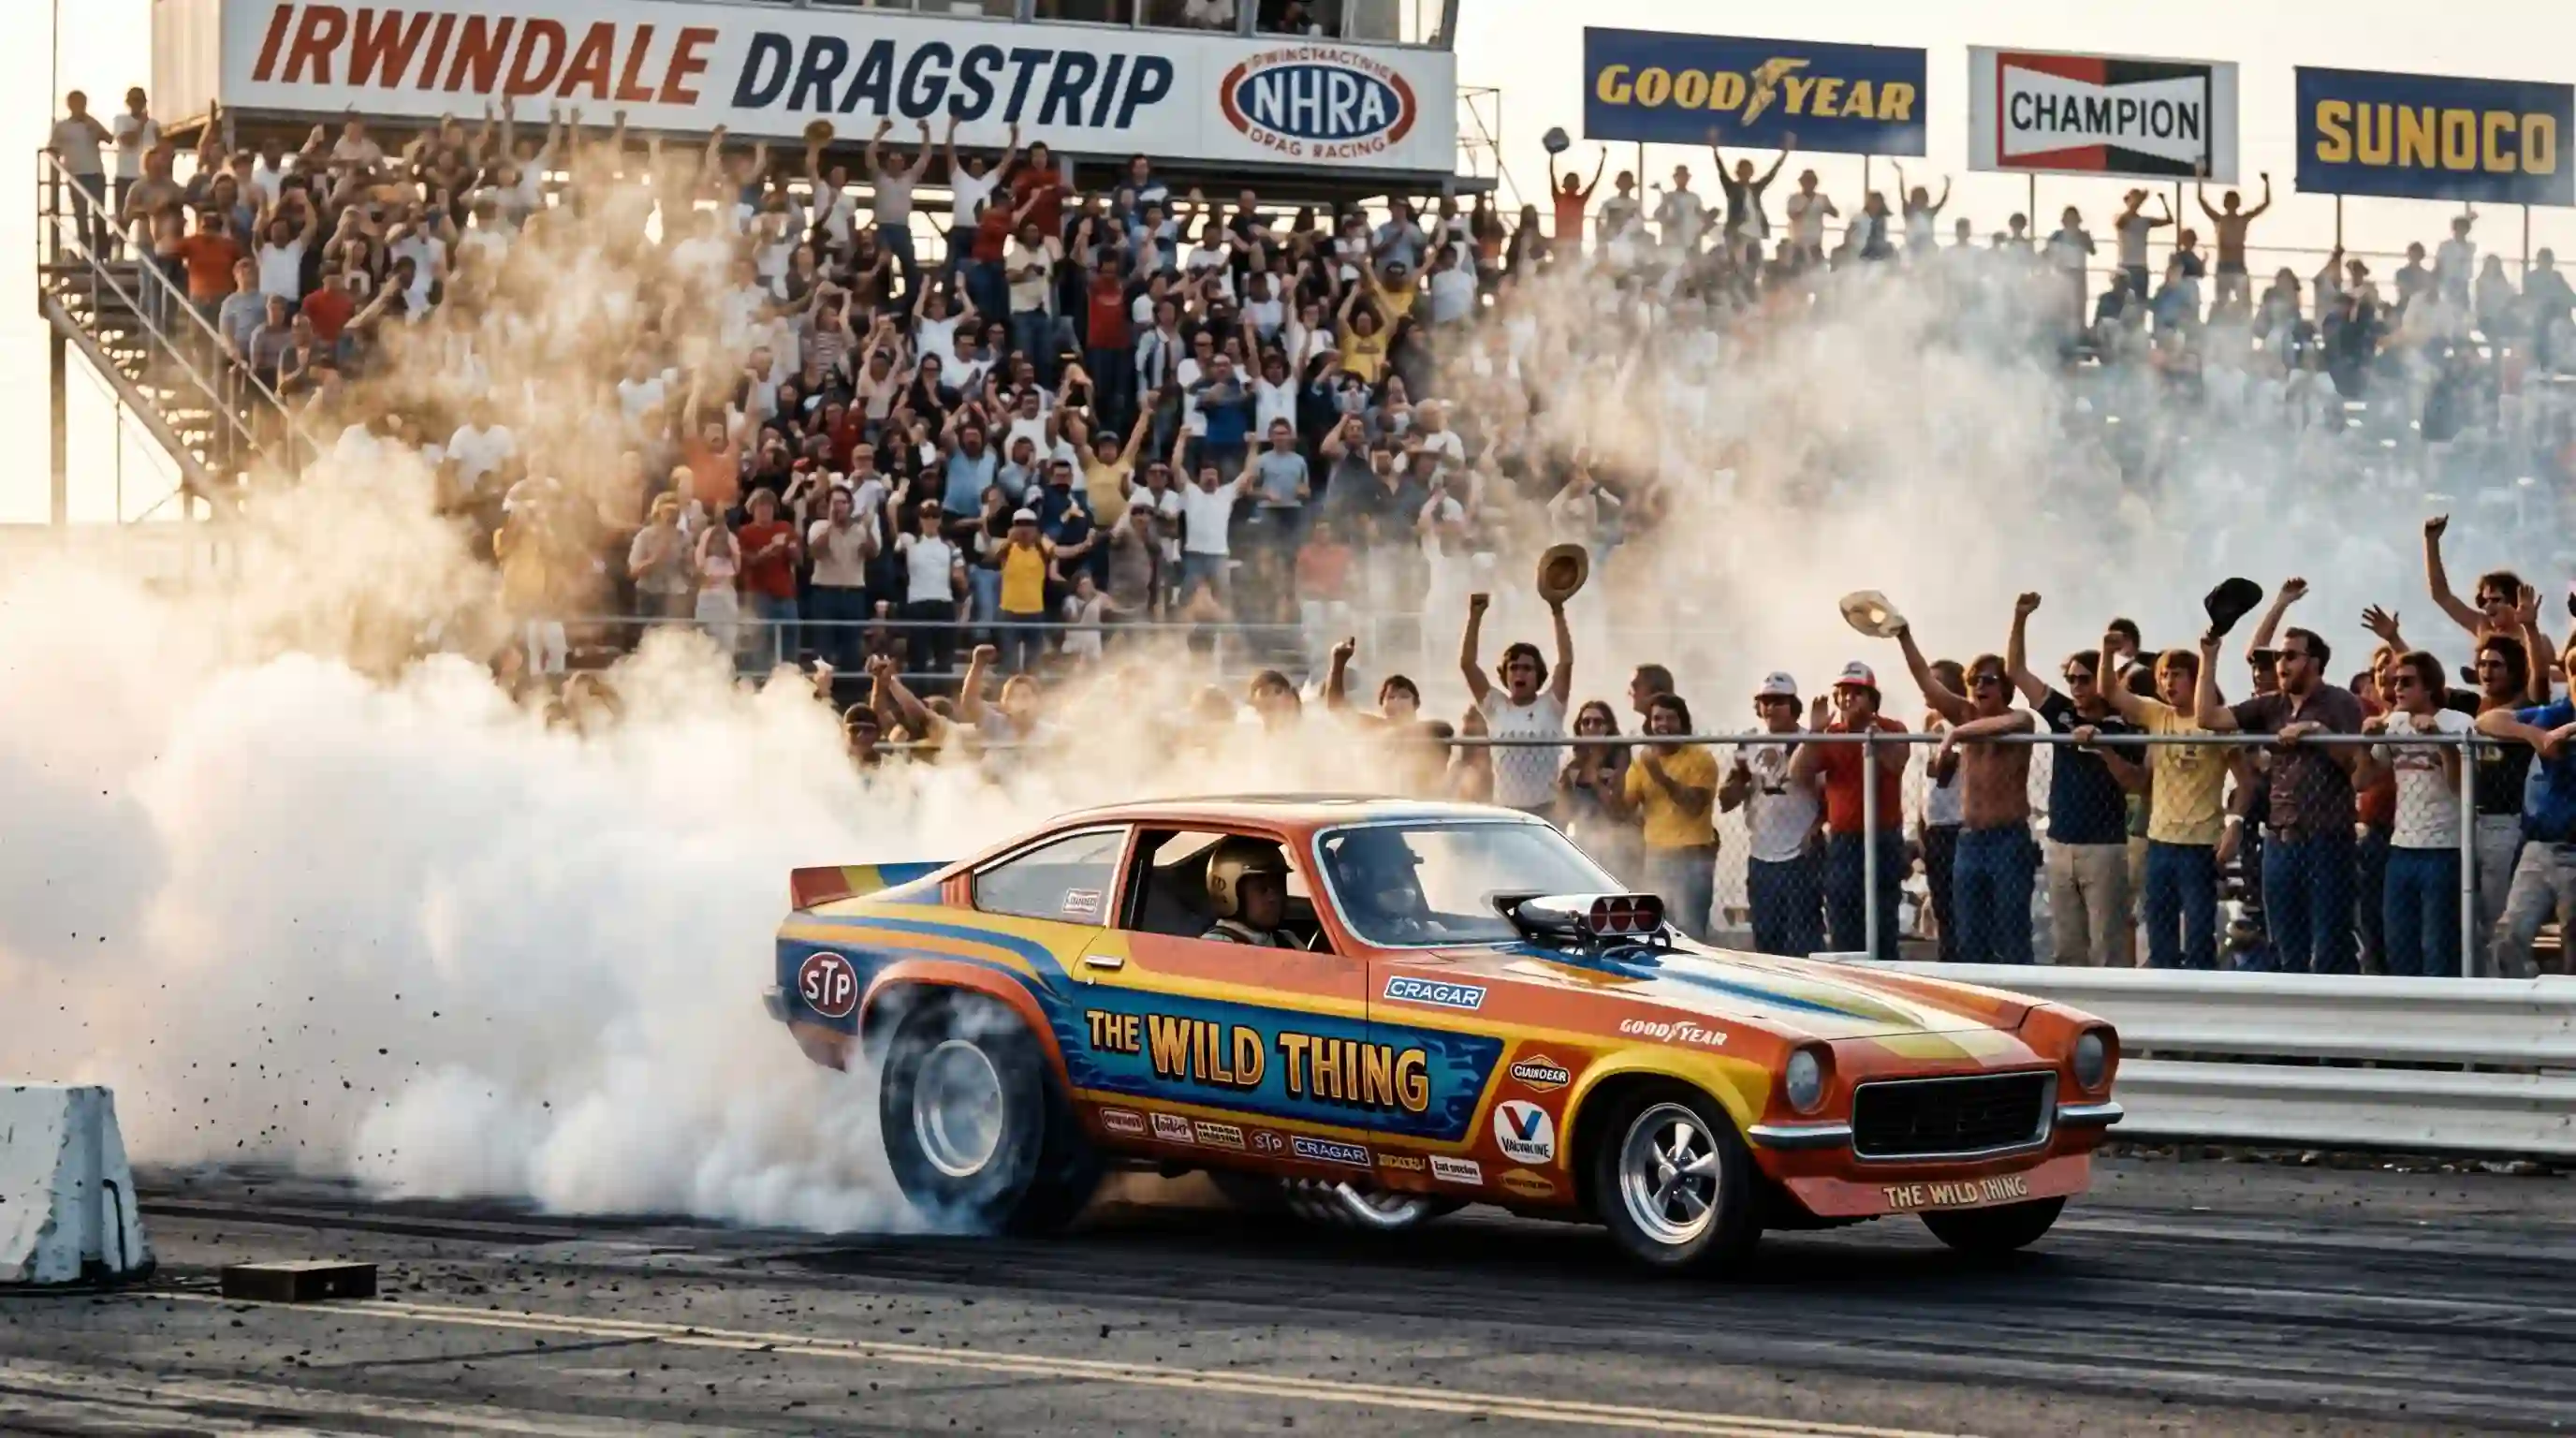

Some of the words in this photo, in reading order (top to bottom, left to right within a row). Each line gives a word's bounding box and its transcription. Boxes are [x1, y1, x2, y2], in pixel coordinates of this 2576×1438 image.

[252, 3, 719, 106] IRWINDALE
[731, 31, 1174, 129] DRAGSTRIP
[1596, 63, 1746, 110] GOOD
[1782, 76, 1915, 121] YEAR
[1254, 68, 1386, 135] NHRA
[2011, 91, 2199, 140] CHAMPION
[2316, 98, 2557, 175] SUNOCO
[805, 960, 851, 1005] STP
[1390, 981, 1479, 1005] CRAGAR
[1086, 1009, 1141, 1051] THE
[1147, 1014, 1266, 1088] WILD
[1279, 1032, 1431, 1112] THING
[1295, 1140, 1367, 1163] CRAGAR
[1883, 1185, 1925, 1208] THE
[1928, 1181, 1978, 1205] WILD
[1981, 1176, 2027, 1201] THING
